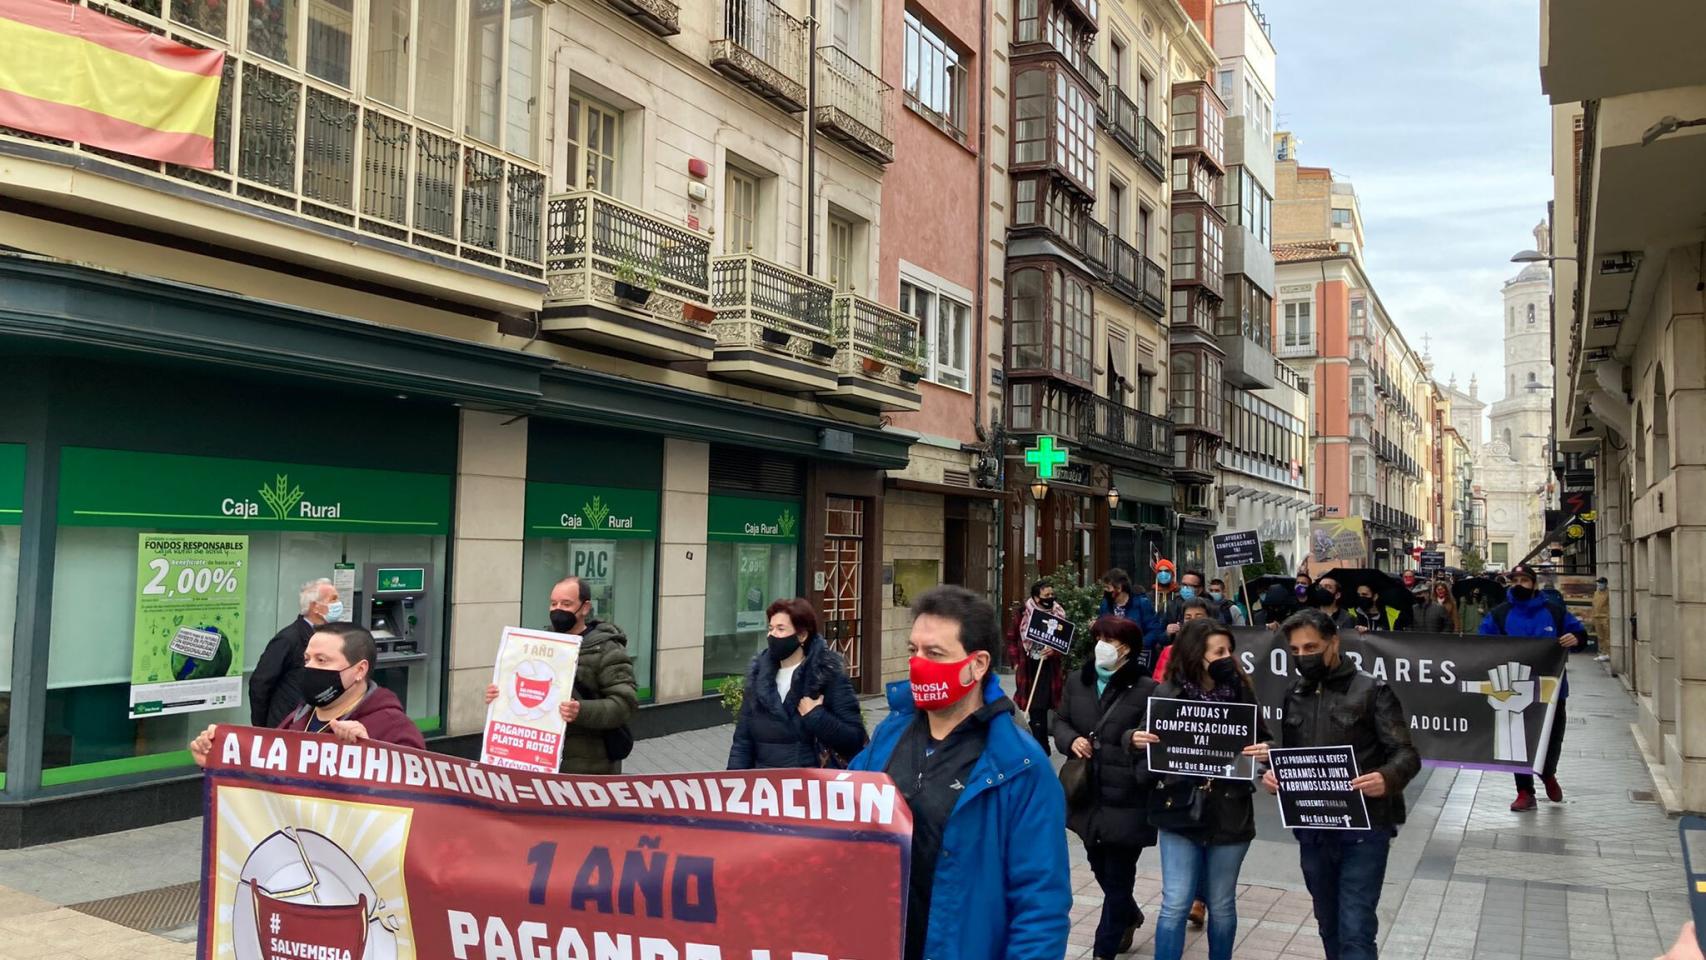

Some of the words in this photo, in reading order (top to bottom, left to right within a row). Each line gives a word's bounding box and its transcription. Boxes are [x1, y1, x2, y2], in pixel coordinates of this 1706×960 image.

[222, 498, 258, 519] Caja
[300, 501, 340, 518] Rural
[560, 513, 582, 529] Caja
[608, 515, 633, 528] Rural
[745, 522, 760, 536] Caja
[760, 523, 778, 534] Rural
[144, 541, 181, 550] FONDOS
[183, 541, 244, 550] RESPONSABLES
[575, 551, 608, 577] PAC
[143, 558, 237, 598] 2,00%
[523, 643, 529, 654] 1
[531, 644, 554, 657] AÑO
[1176, 705, 1220, 719] ¡AYUDAS
[1223, 708, 1229, 719] Y
[494, 723, 538, 740] PAGANDO
[539, 732, 556, 744] LOS
[1155, 719, 1248, 736] COMPENSACIONES
[491, 733, 524, 749] PLATOS
[526, 741, 554, 755] ROTOS
[1193, 735, 1209, 746] YA!
[222, 733, 241, 765] A
[250, 736, 288, 771] LA
[1280, 768, 1317, 779] CERRAMOS
[1318, 767, 1327, 778] LA
[1328, 767, 1349, 778] JUNTA
[1280, 782, 1285, 792] Y
[1286, 781, 1318, 791] ABRIMOS
[1319, 781, 1332, 791] LOS
[1332, 781, 1354, 791] BARES
[528, 842, 557, 906] 1
[571, 834, 717, 923] AÑO
[270, 912, 281, 935] #
[271, 938, 352, 960] SALVEMOSLA
